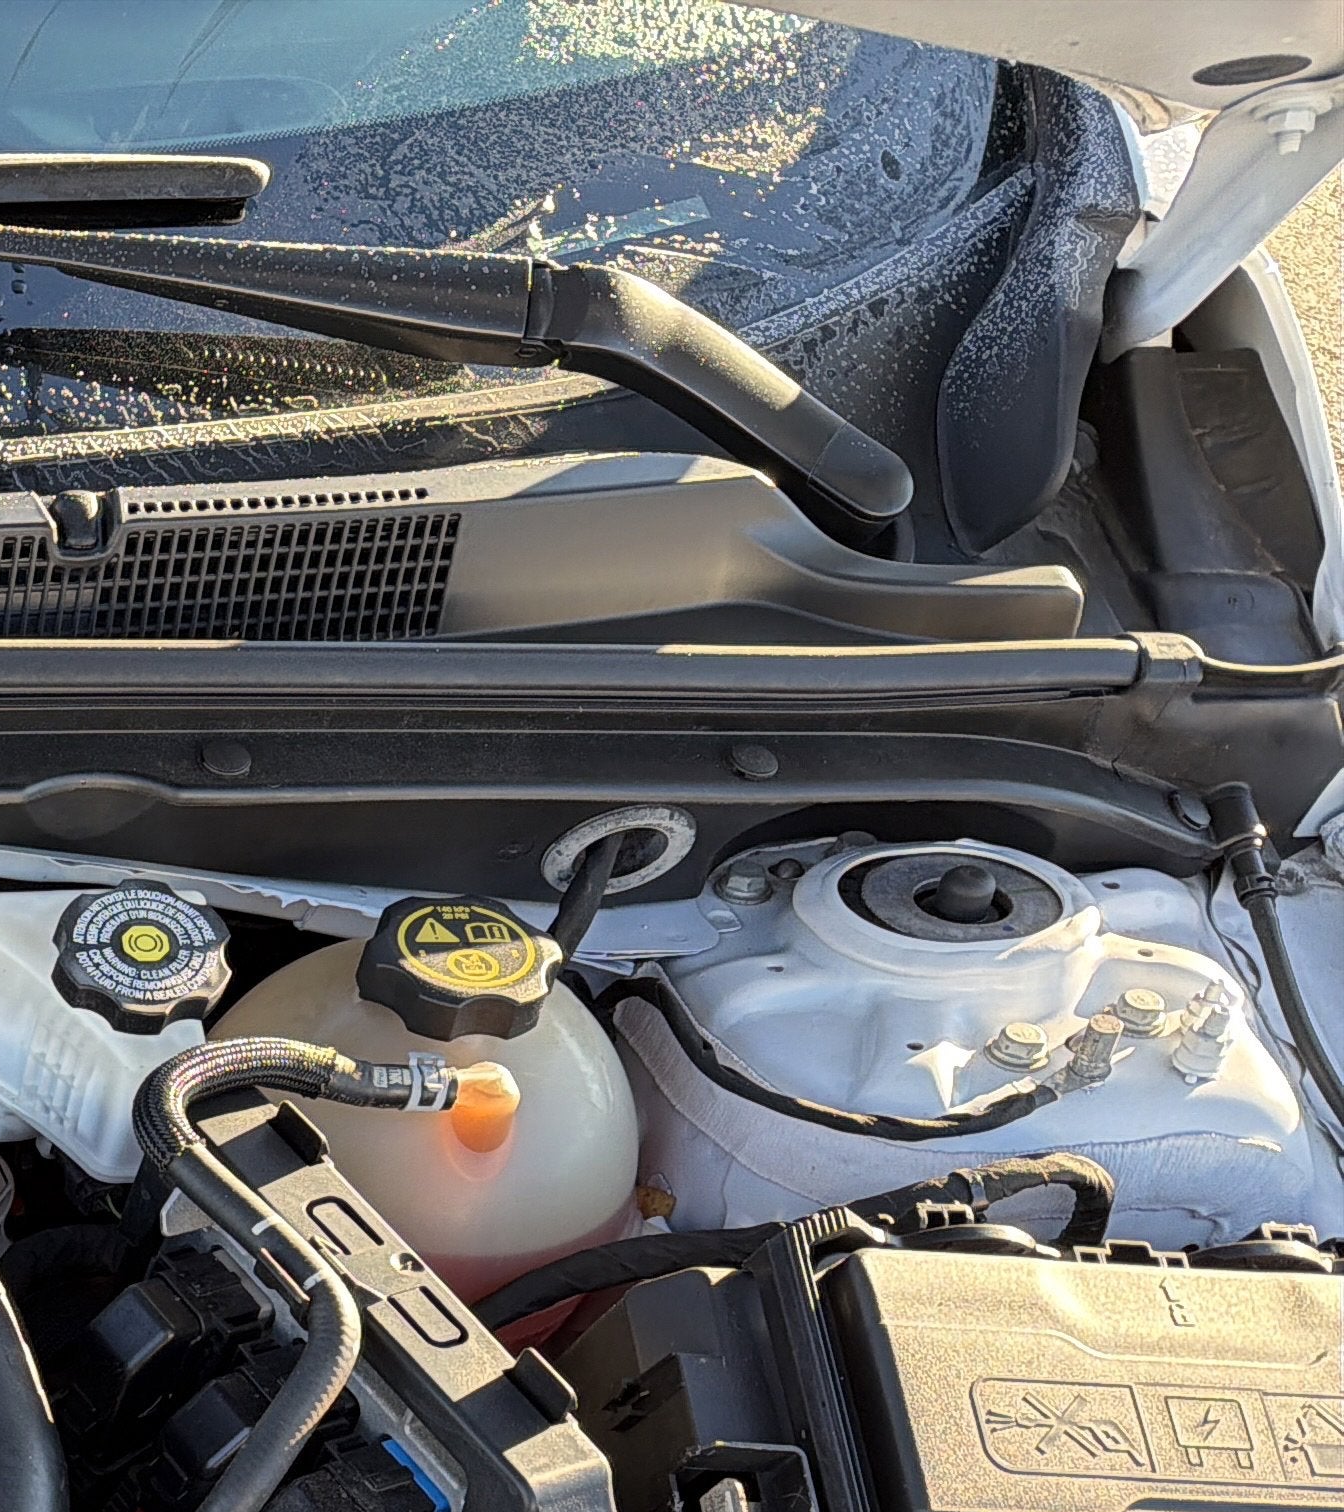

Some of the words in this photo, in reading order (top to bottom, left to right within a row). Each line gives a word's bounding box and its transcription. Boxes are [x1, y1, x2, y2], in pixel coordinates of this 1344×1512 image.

[125, 890, 137, 899] LE
[165, 906, 177, 916] DE
[89, 949, 105, 964] CAP
[99, 963, 133, 986] BEFORE
[141, 967, 172, 979] CLEAN
[169, 950, 191, 973] FILLER
[89, 970, 116, 990] FLUID
[115, 984, 144, 999] FROM
[145, 991, 152, 1000] A
[153, 984, 190, 1000] SEALED
